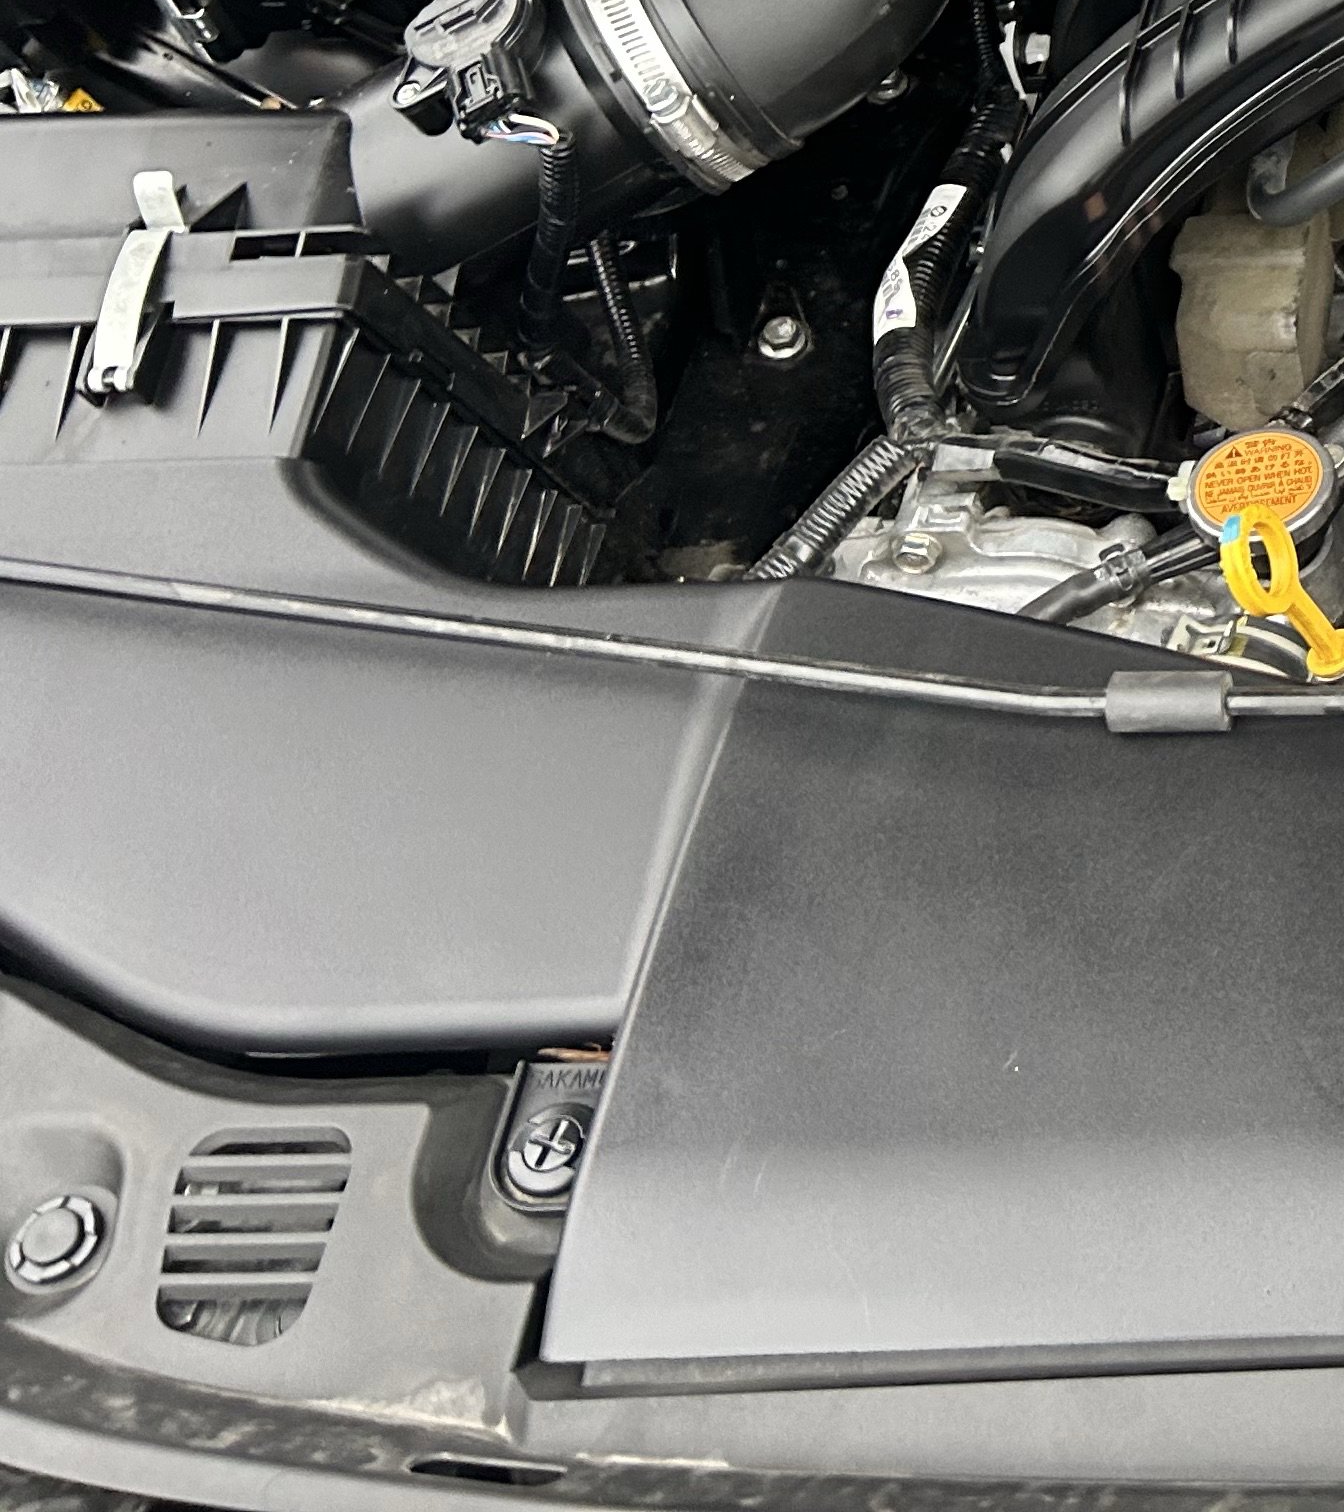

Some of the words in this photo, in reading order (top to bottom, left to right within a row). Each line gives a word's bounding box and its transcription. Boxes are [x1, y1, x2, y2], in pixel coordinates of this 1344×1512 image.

[1204, 478, 1234, 489] NEVER
[1236, 474, 1261, 485] OPEN
[1264, 469, 1291, 481] WHEN
